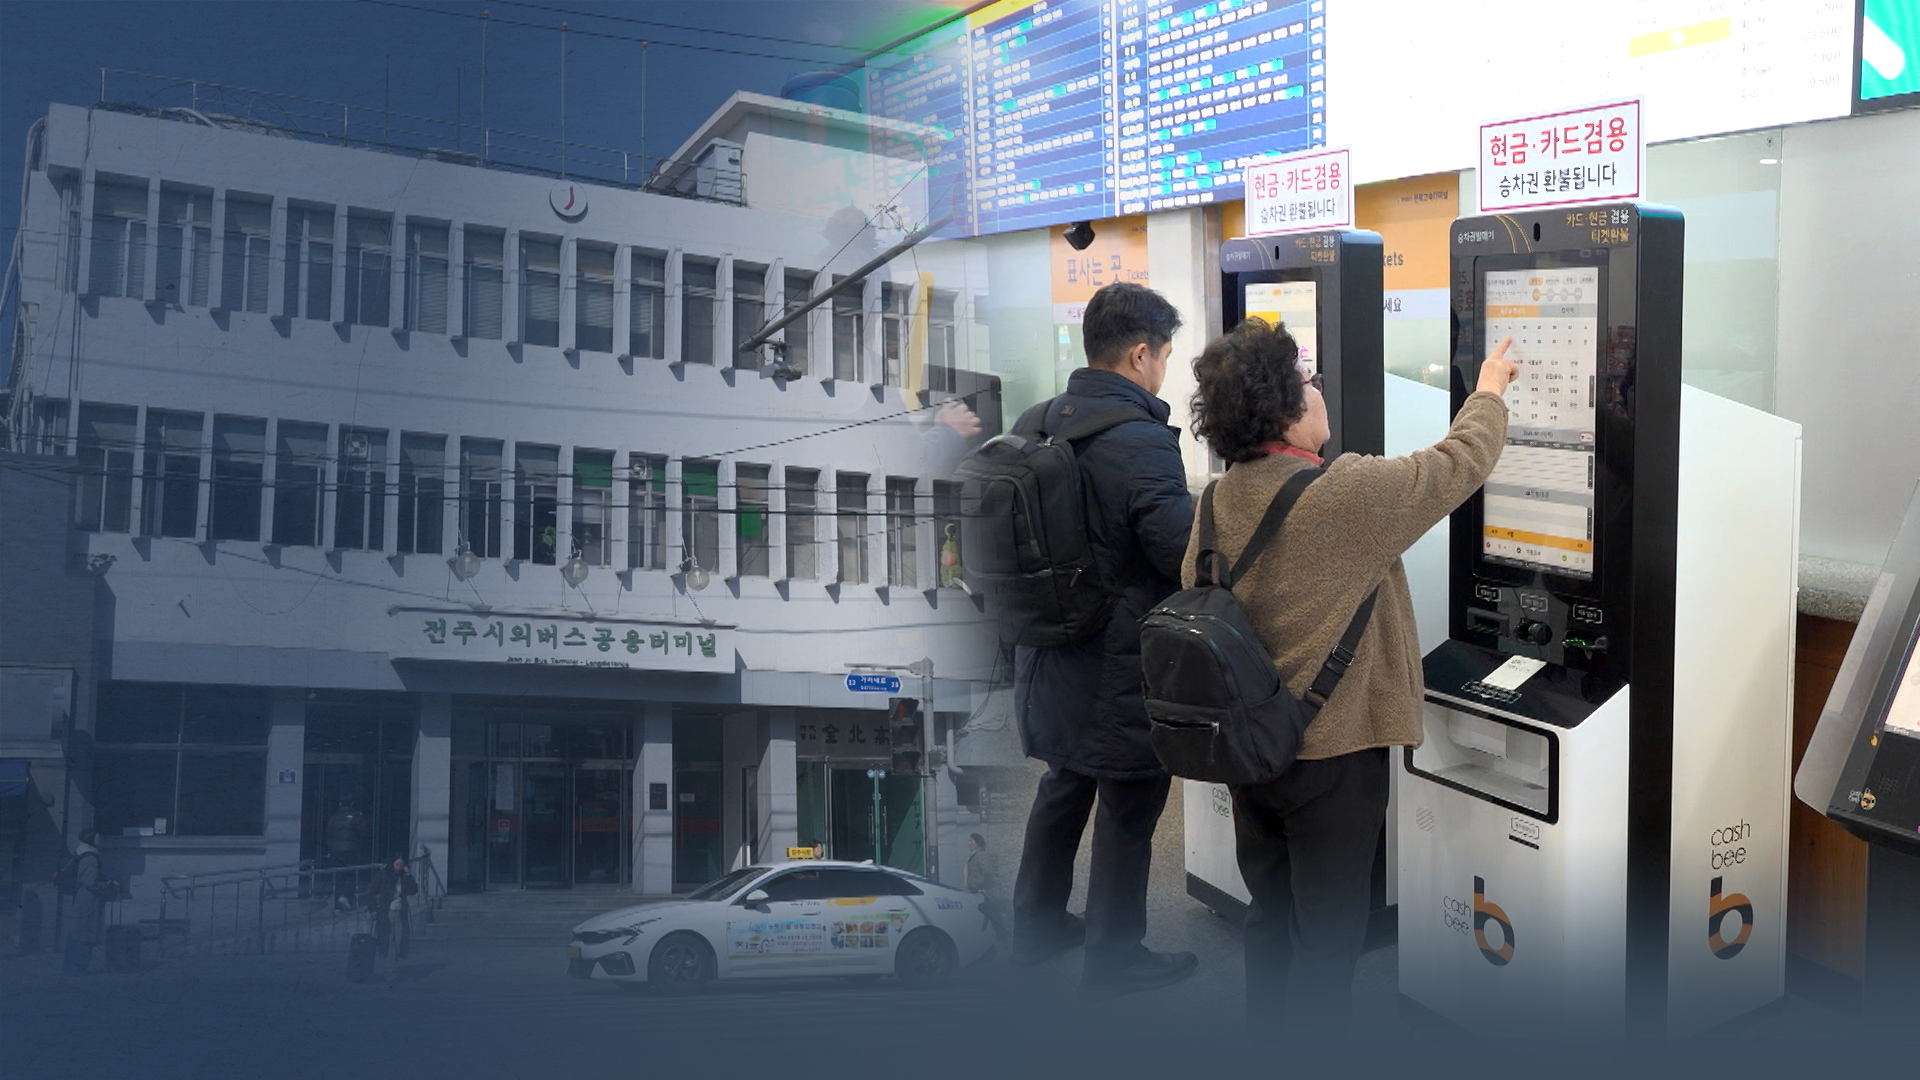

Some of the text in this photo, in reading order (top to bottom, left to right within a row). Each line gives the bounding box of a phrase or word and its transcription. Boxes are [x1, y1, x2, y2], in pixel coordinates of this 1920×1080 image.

[1489, 117, 1628, 166] 현금·카드겸용
[1254, 162, 1342, 200] 현금·카드겸용
[1499, 161, 1617, 198] 승차권 환불됩니다
[1260, 197, 1336, 224] 승차권 환불됩니다
[1611, 209, 1629, 224] 겸용
[1457, 229, 1495, 244] 승차권발매기
[1591, 227, 1630, 244] 티켓환불
[1067, 257, 1103, 286] 표사는
[422, 617, 717, 657] 전주시외버스공용터미널
[1710, 818, 1751, 847] cash
[1711, 847, 1747, 870] bee
[1443, 895, 1472, 919] cash
[1444, 909, 1470, 936] bee
